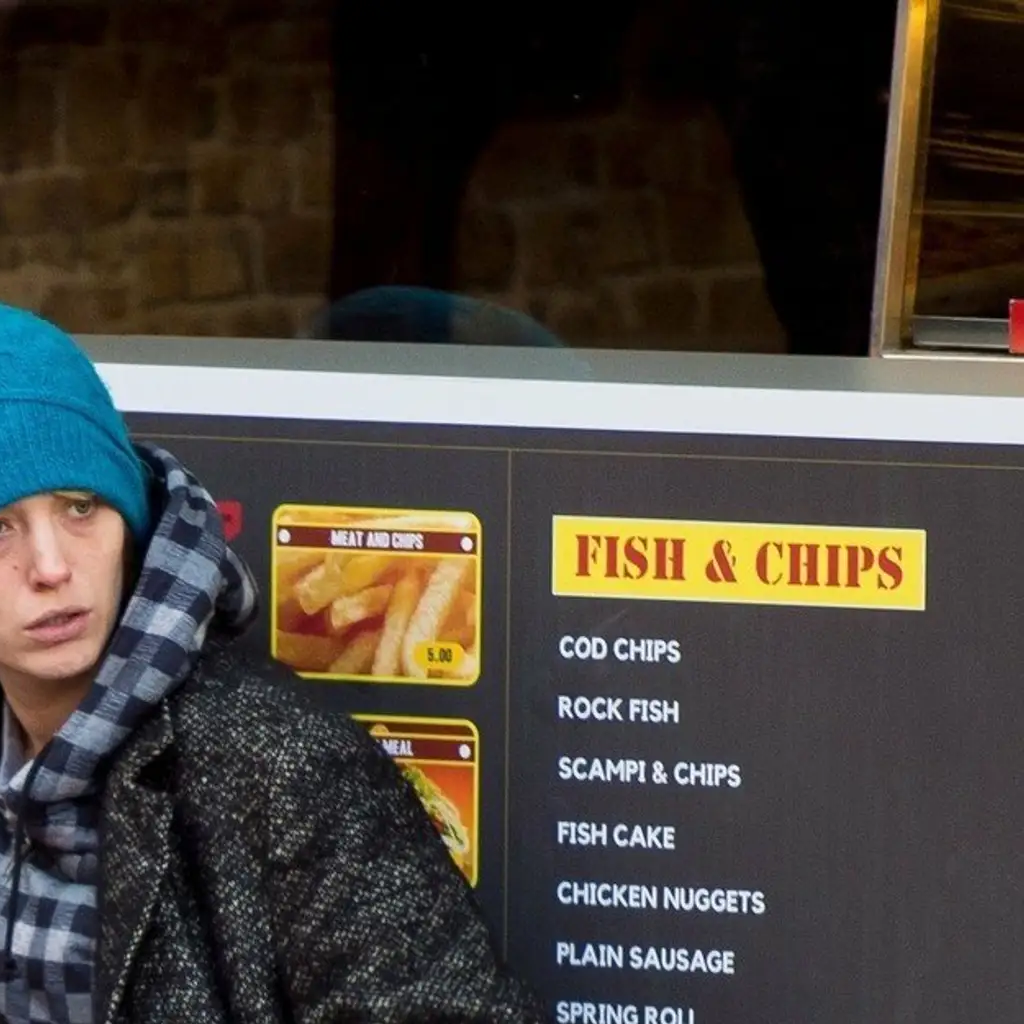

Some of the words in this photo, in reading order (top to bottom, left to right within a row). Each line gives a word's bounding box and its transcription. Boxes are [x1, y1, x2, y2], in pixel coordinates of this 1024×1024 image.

[330, 528, 363, 548] MEAT
[366, 531, 390, 548] AND
[391, 532, 424, 550] CHIPS
[575, 535, 686, 581] FISH
[705, 539, 737, 583] &
[755, 541, 903, 590] CHIPS
[427, 647, 453, 664] 5.00
[559, 635, 608, 660] COD
[613, 637, 682, 663] CHIPS
[558, 695, 624, 722] ROCK
[629, 698, 680, 724] FISH
[382, 739, 414, 756] MEAL
[558, 756, 647, 784] SCAMPI
[651, 759, 668, 785] &
[674, 761, 742, 789] CHIPS
[557, 820, 608, 846] FISH
[613, 823, 676, 850] CAKE
[557, 881, 658, 909] CHICKEN
[663, 886, 766, 915] NUGGETS
[556, 942, 624, 969] PLAIN
[629, 945, 736, 975] SAUSAGE
